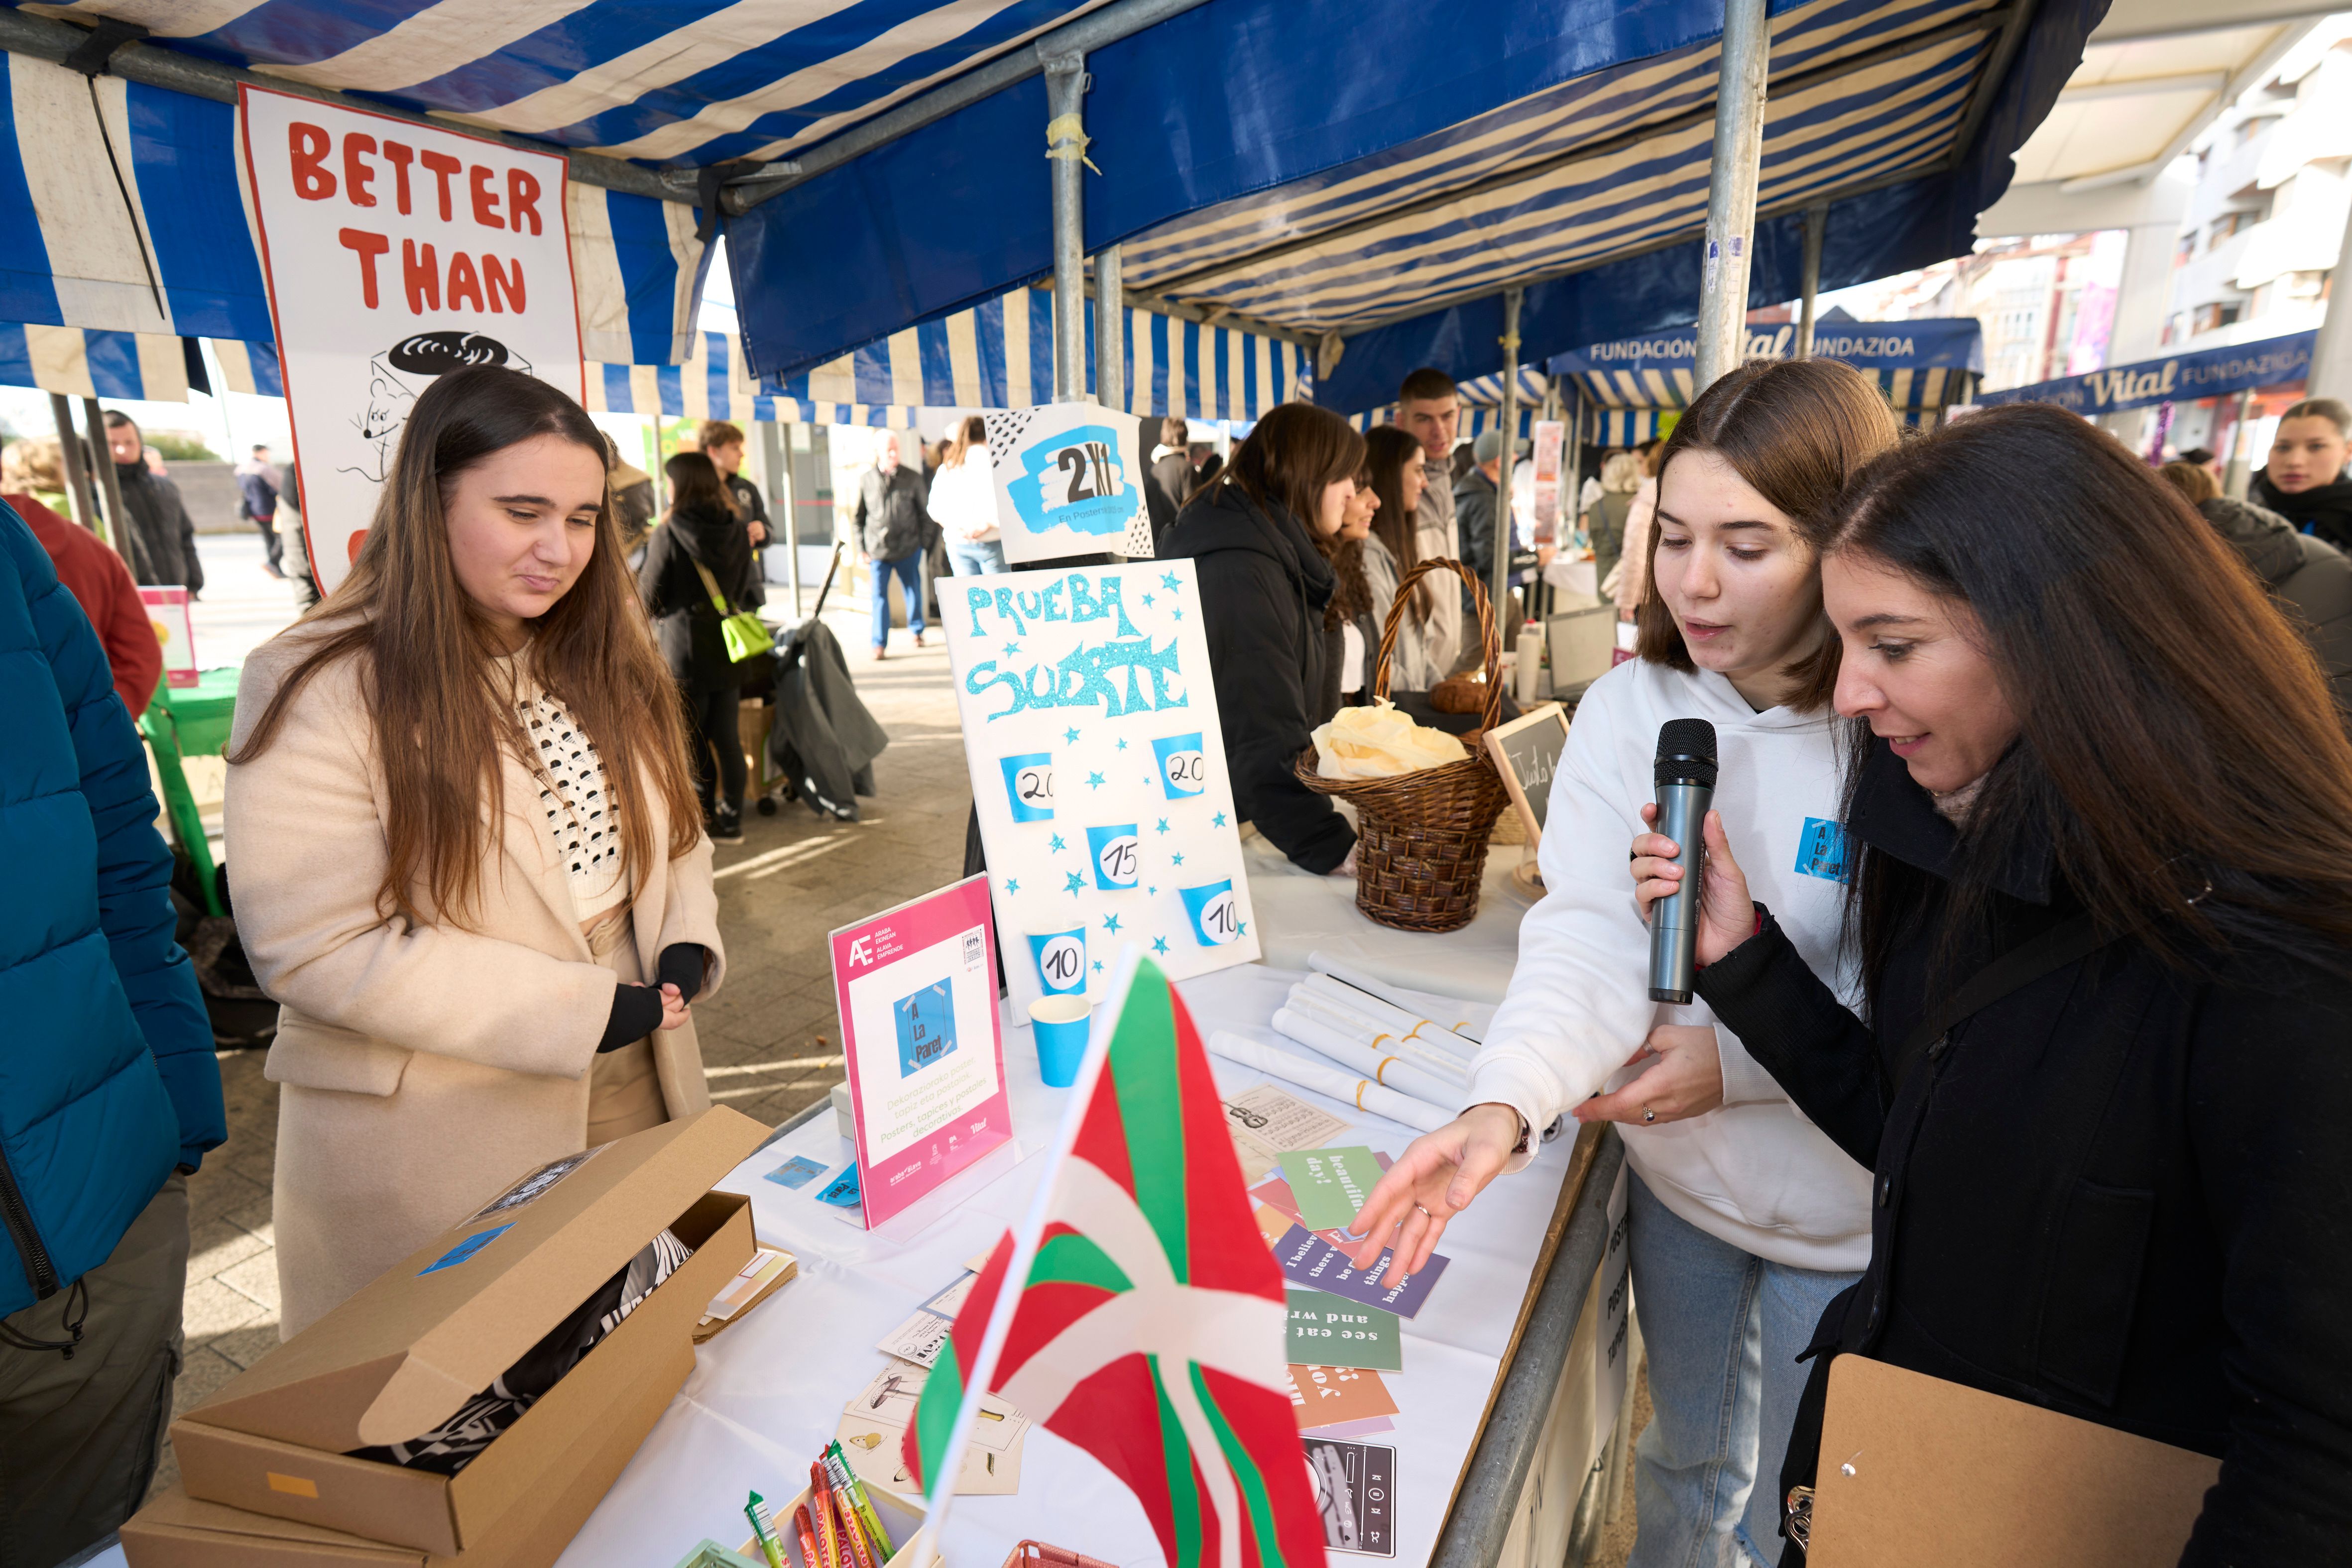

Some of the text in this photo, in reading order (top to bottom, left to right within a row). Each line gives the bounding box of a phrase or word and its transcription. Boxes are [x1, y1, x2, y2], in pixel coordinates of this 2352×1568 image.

[289, 122, 542, 235] BETTER
[340, 227, 526, 315] THAN
[1591, 326, 1915, 361] FUNDACIÓN tal UNDAZIOA
[2084, 360, 2179, 407] Vital
[2182, 349, 2310, 387] FUNDAZIOA
[1059, 515, 1071, 523] En
[967, 573, 1144, 638] PRUEBA
[965, 634, 1188, 723] SUERTE
[1170, 756, 1203, 781] 20
[1818, 826, 1826, 839] A
[1104, 842, 1137, 877] 15
[1814, 842, 1827, 856] La
[1811, 858, 1841, 875] Paret
[1208, 901, 1236, 934] 10
[875, 927, 891, 938] ARABA
[875, 931, 896, 944] EKINEAN
[877, 944, 904, 960] EMPRENDE
[1046, 947, 1077, 980] 10
[912, 1003, 919, 1021] A
[913, 1024, 926, 1042] La
[916, 1034, 942, 1063] Paret
[887, 1072, 949, 1111] Dekoraziorako
[917, 1101, 948, 1123] tapices
[949, 1097, 954, 1107] y
[956, 1076, 987, 1103] postales
[895, 1101, 918, 1120] tapiz
[920, 1093, 935, 1106] eta
[913, 1105, 963, 1138] decorativas.
[970, 1117, 987, 1134] Vital
[890, 1171, 905, 1184] araba
[1306, 1157, 1332, 1184] day!
[1328, 1155, 1365, 1213] beautifu
[1291, 1234, 1318, 1262] believ
[1609, 1210, 1627, 1261] POSTE
[1309, 1252, 1334, 1278] there
[1336, 1268, 1352, 1280] be
[1364, 1256, 1391, 1286] things
[1382, 1271, 1410, 1303] happe
[1283, 1310, 1368, 1324] and wri
[1296, 1327, 1332, 1338] eat
[1341, 1330, 1378, 1341] see
[915, 1336, 946, 1360] HAPPY
[843, 1510, 869, 1567] PALOTES
